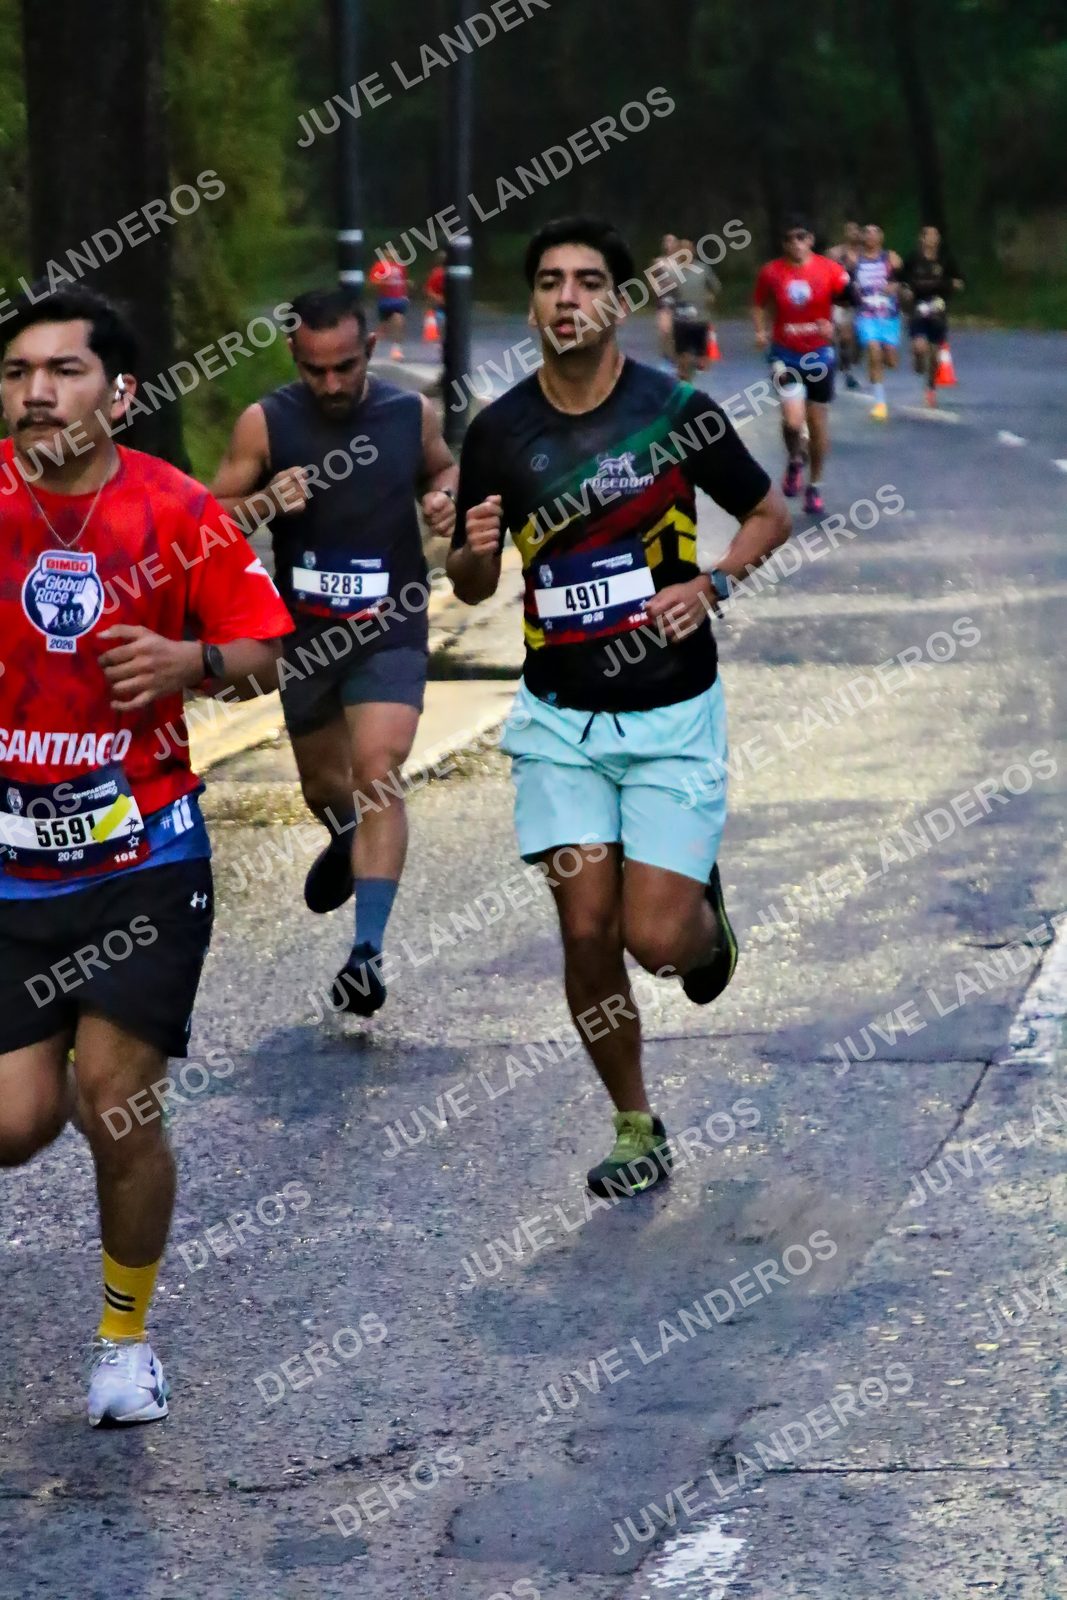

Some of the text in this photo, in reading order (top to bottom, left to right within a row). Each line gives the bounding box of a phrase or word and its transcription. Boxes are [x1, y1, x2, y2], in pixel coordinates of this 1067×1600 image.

[46, 558, 88, 572] BIMBO
[45, 575, 86, 594] Global
[320, 573, 363, 595] 5283
[35, 587, 69, 605] Race
[565, 580, 610, 612] 4917
[49, 639, 73, 650] 2026
[35, 813, 96, 848] 5591
[113, 850, 138, 863] 10K
